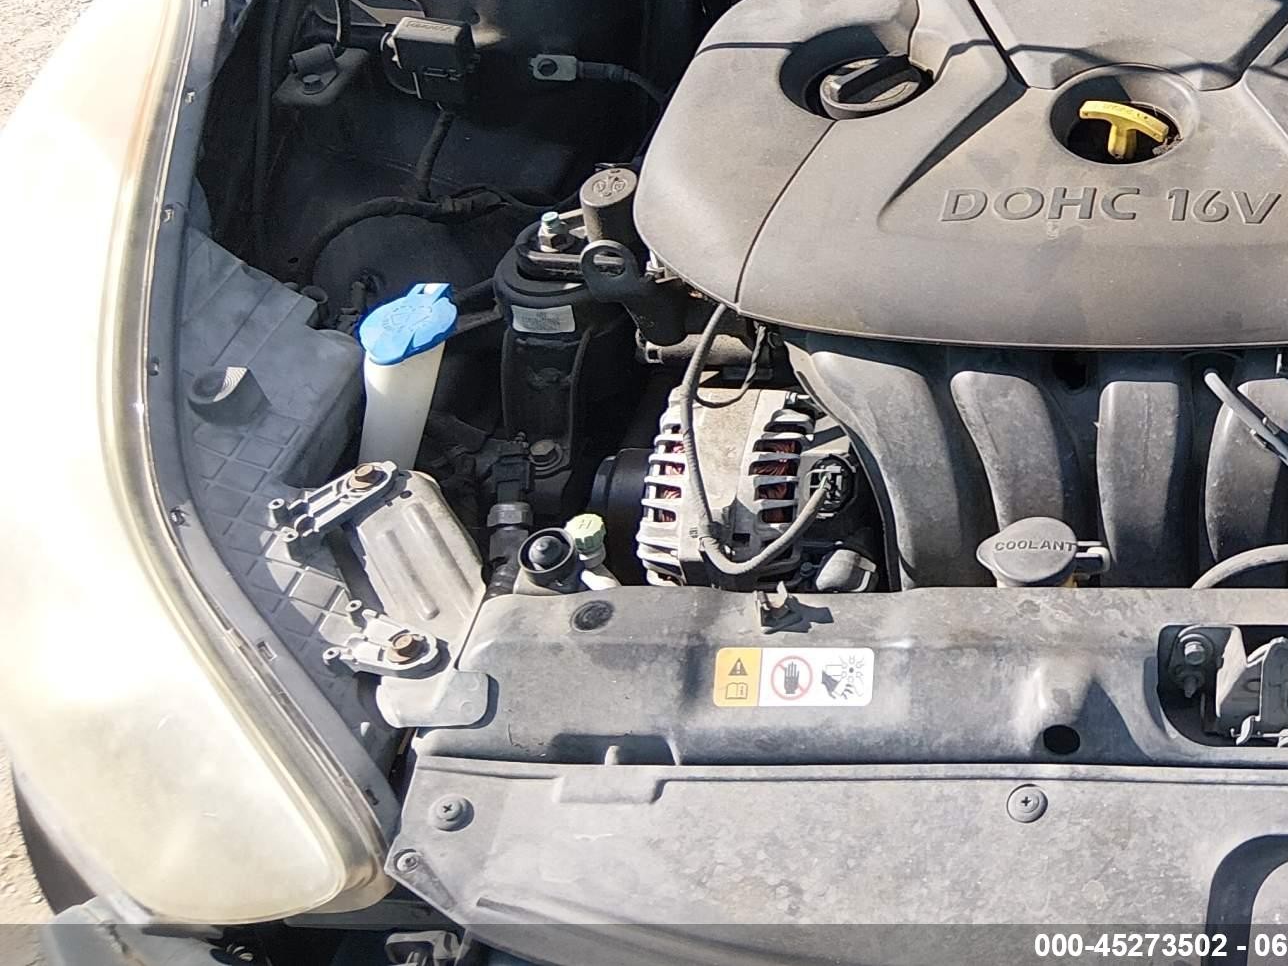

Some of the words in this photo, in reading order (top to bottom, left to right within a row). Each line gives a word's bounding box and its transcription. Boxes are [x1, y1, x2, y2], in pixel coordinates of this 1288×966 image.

[941, 187, 1141, 222] DOHC
[1167, 188, 1282, 224] 16V
[994, 540, 1078, 552] COOLANT
